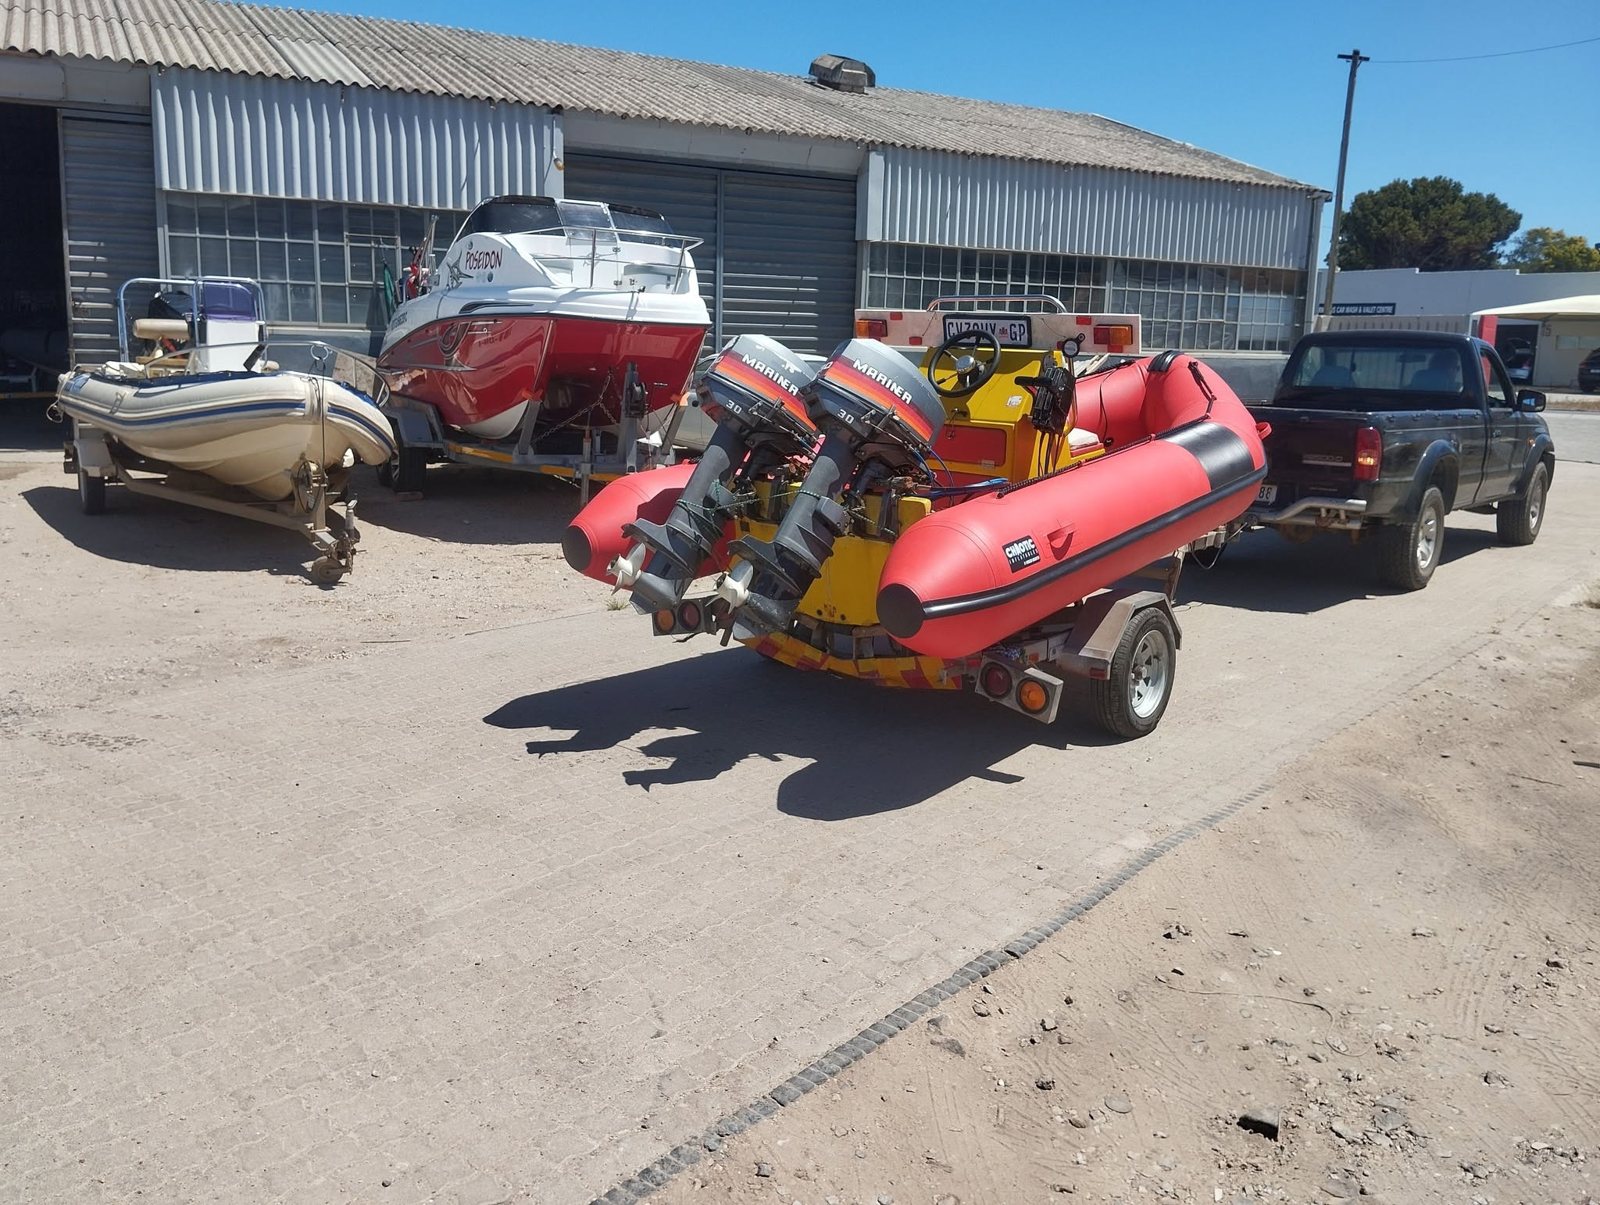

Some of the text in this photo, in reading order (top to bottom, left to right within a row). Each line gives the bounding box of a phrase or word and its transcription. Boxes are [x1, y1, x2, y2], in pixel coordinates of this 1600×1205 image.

[465, 248, 503, 270] POSEIDON
[1009, 323, 1026, 342] GP
[741, 353, 800, 397] MARINER
[852, 359, 913, 405] MARINER
[725, 400, 742, 414] 30
[837, 408, 855, 424] 30
[1005, 538, 1036, 558] CHAOTIC
